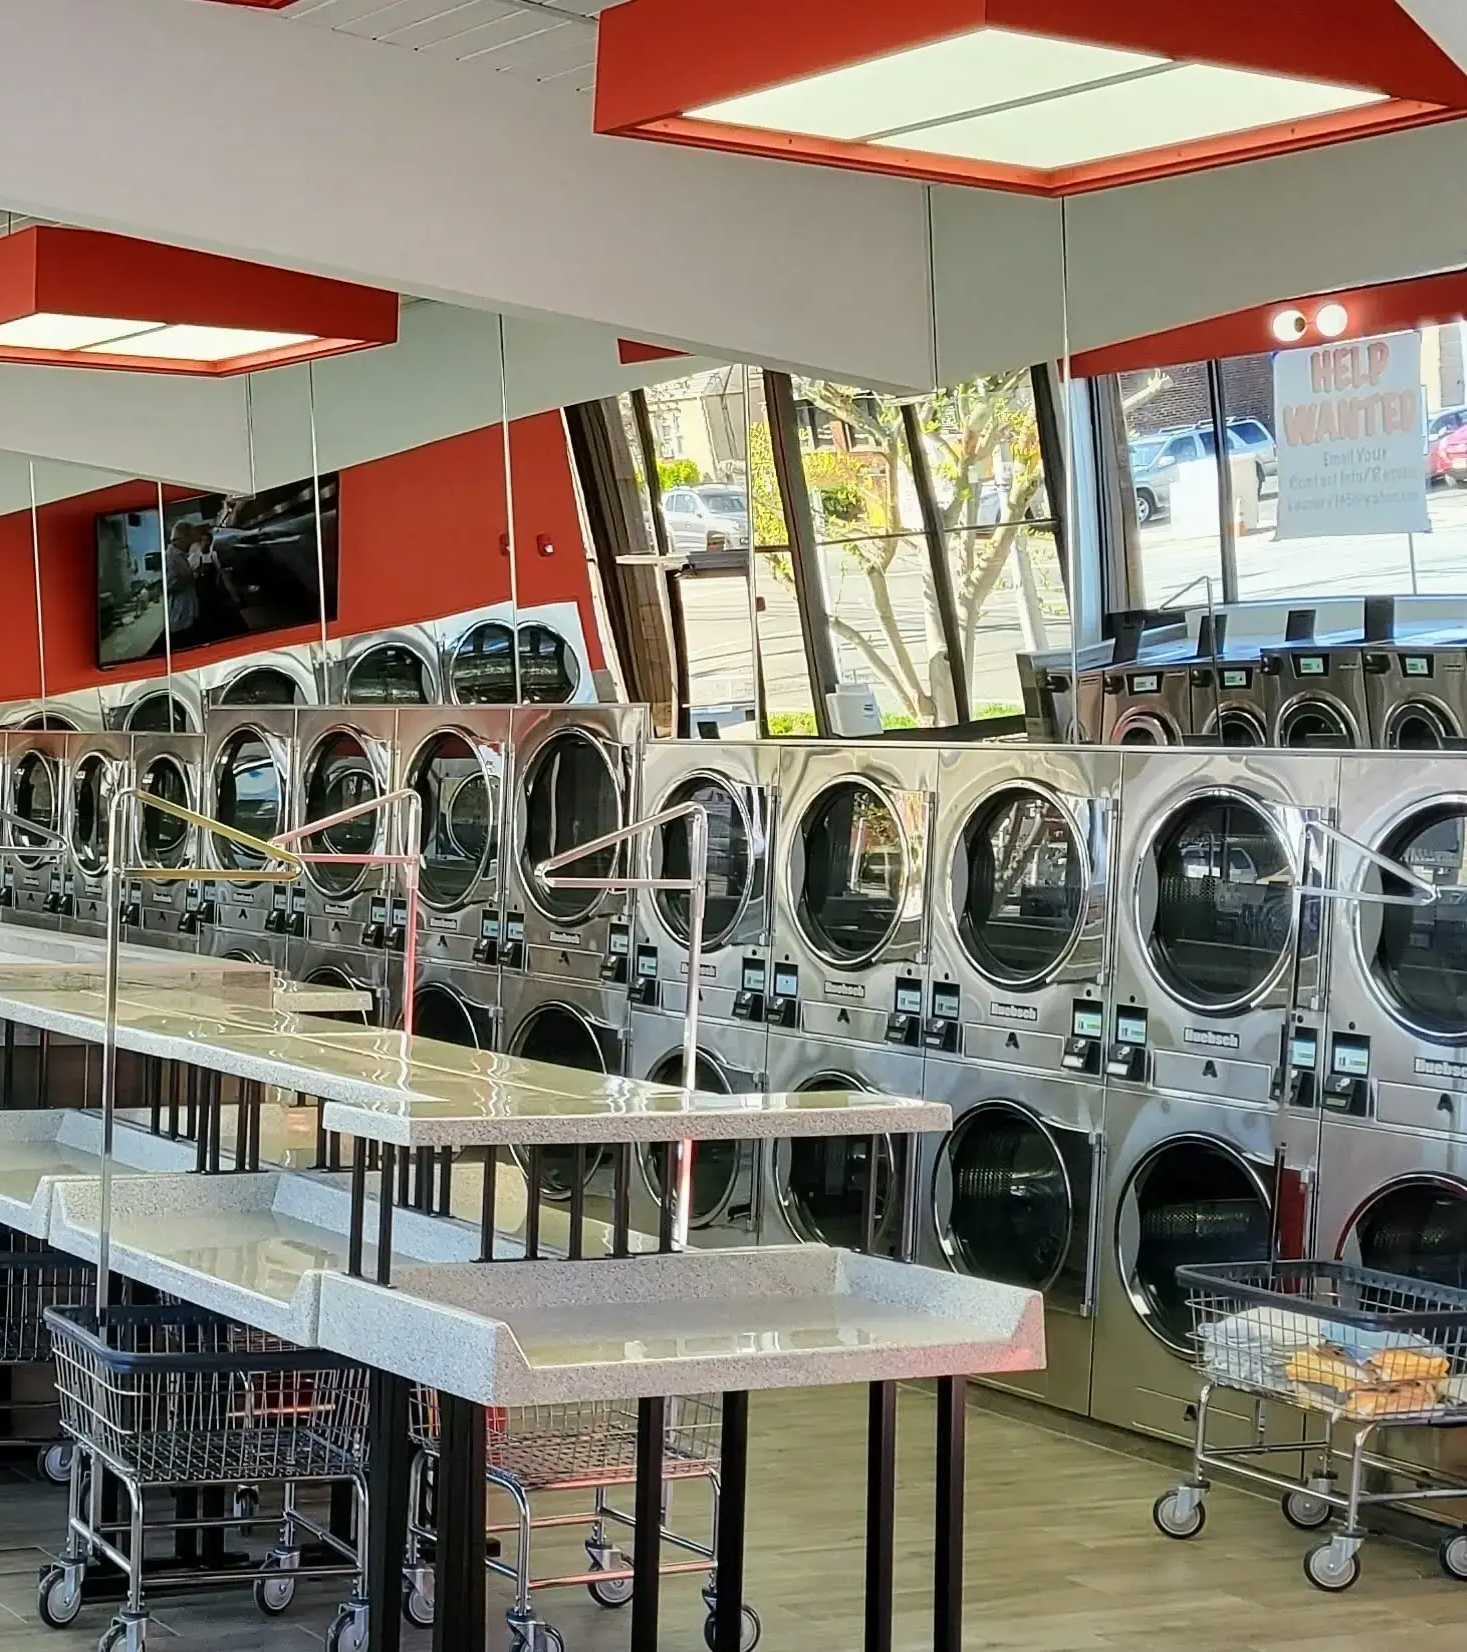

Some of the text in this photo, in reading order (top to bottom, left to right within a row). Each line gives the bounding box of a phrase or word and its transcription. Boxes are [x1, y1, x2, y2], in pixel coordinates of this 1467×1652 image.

[1310, 342, 1390, 393] HELP
[1284, 390, 1416, 445] WANTED
[1323, 447, 1387, 467] Email Your
[1185, 1028, 1238, 1047] Huebsch
[1415, 1058, 1467, 1078] Huebsc
